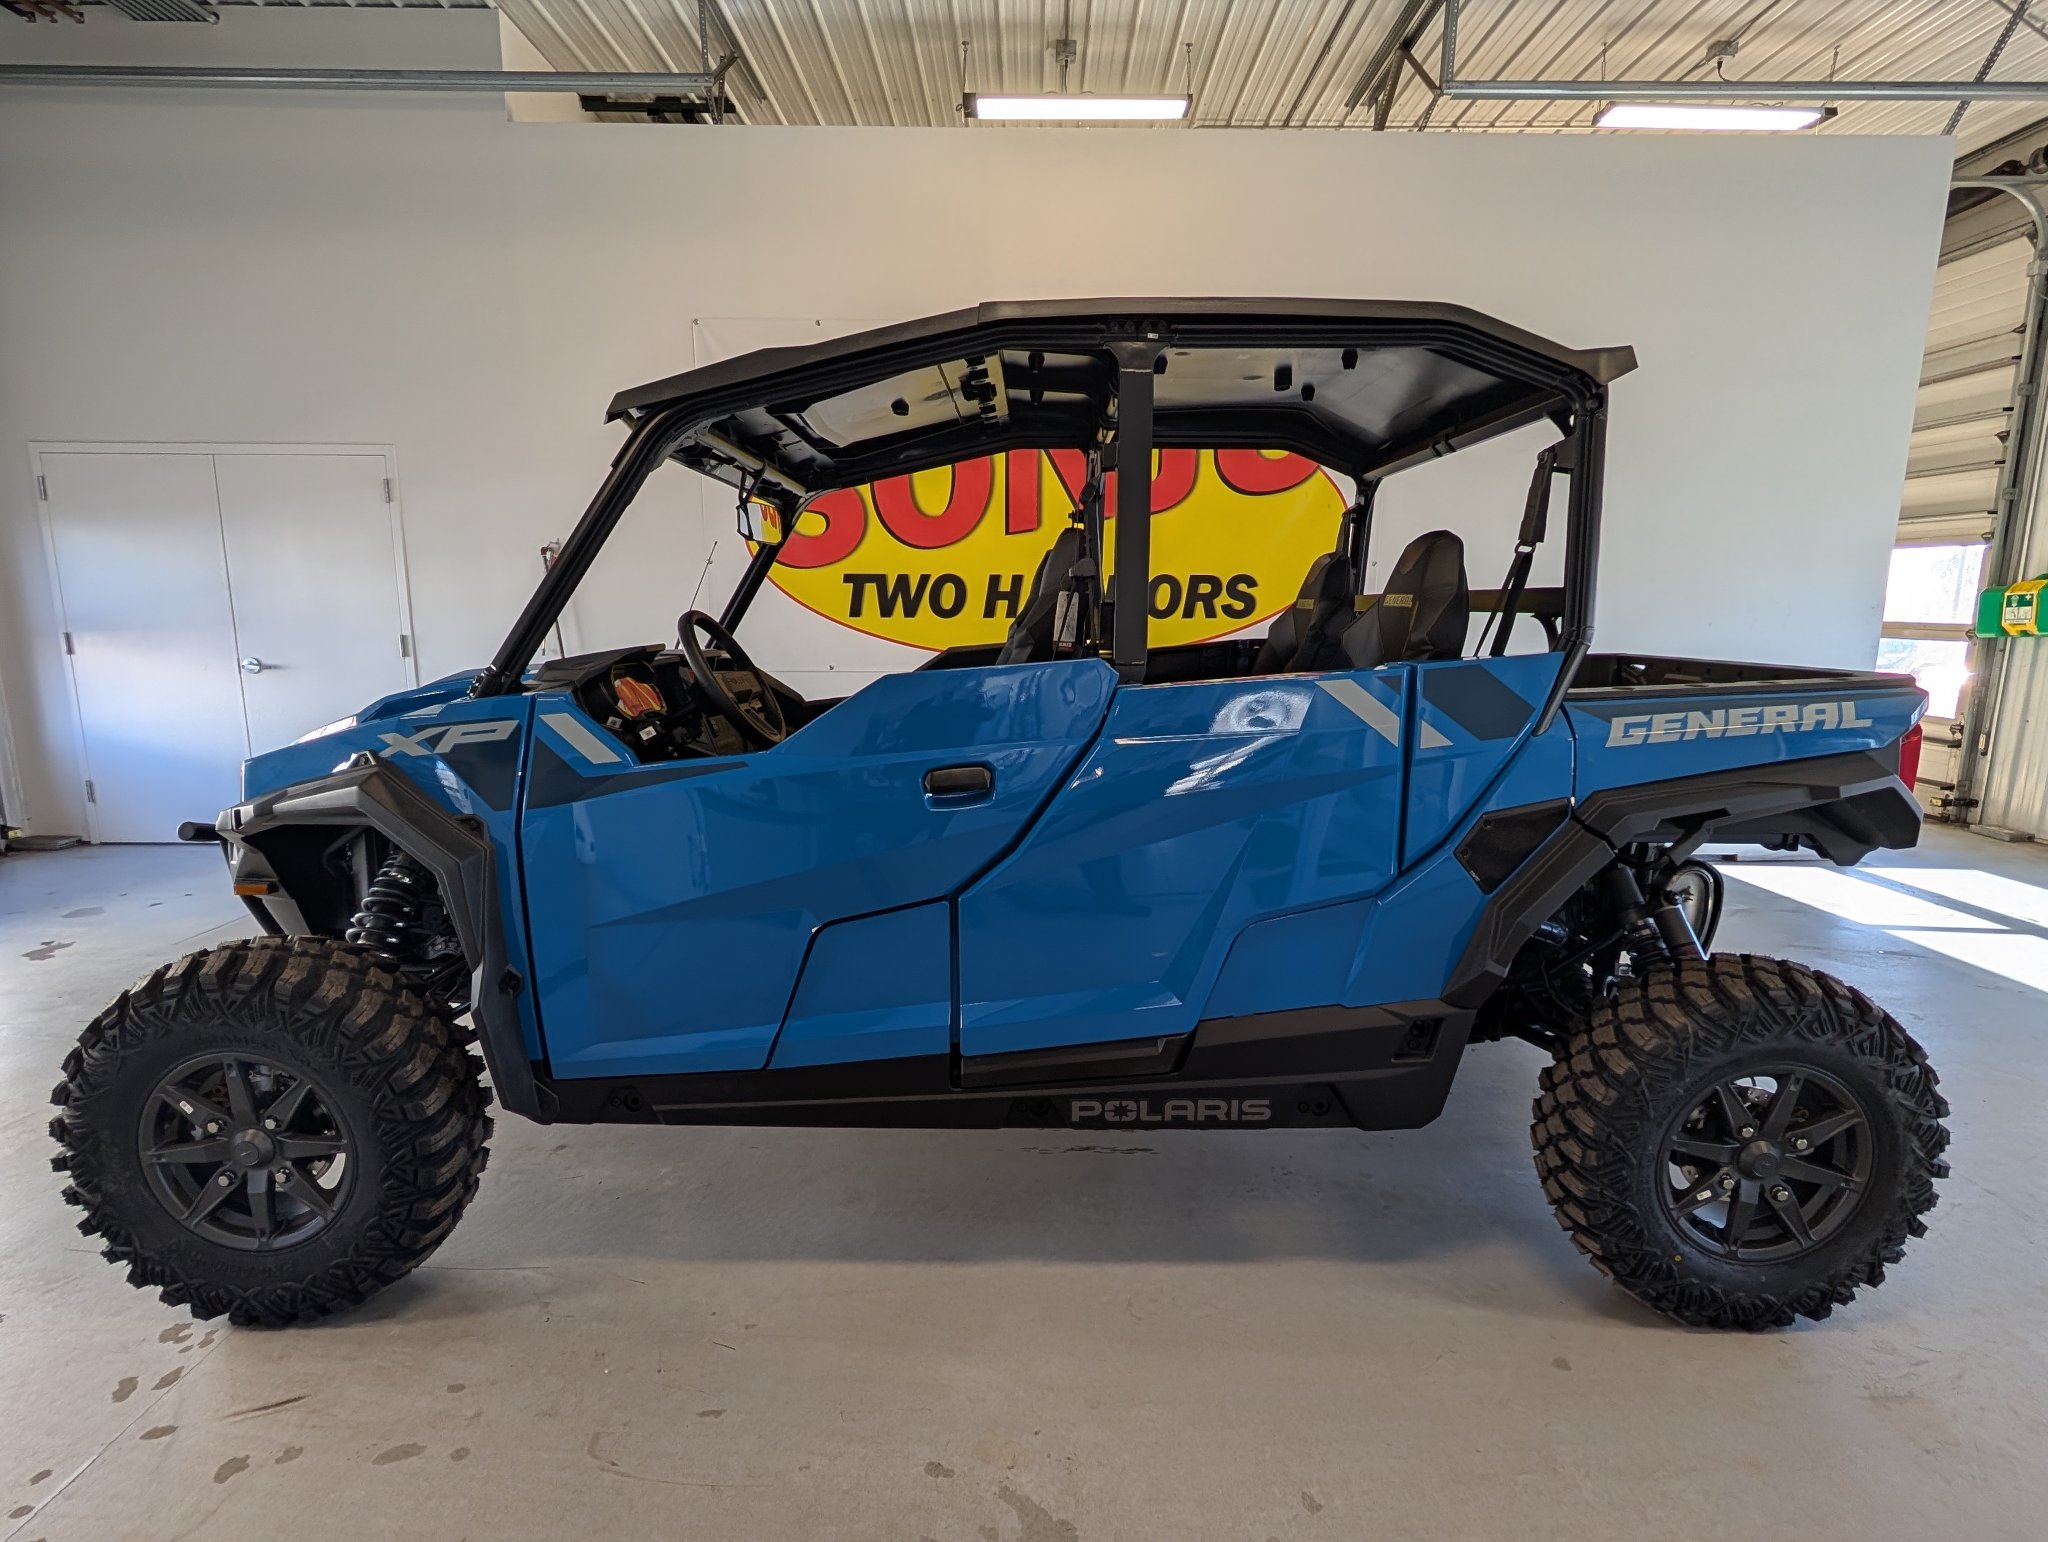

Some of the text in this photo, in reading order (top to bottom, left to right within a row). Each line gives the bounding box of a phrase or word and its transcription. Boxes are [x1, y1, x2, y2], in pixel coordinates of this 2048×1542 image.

[843, 573, 967, 619] TWO
[377, 720, 519, 757] XP
[1605, 701, 1872, 747] GENERAL
[1071, 1100, 1271, 1121] POLARIS
